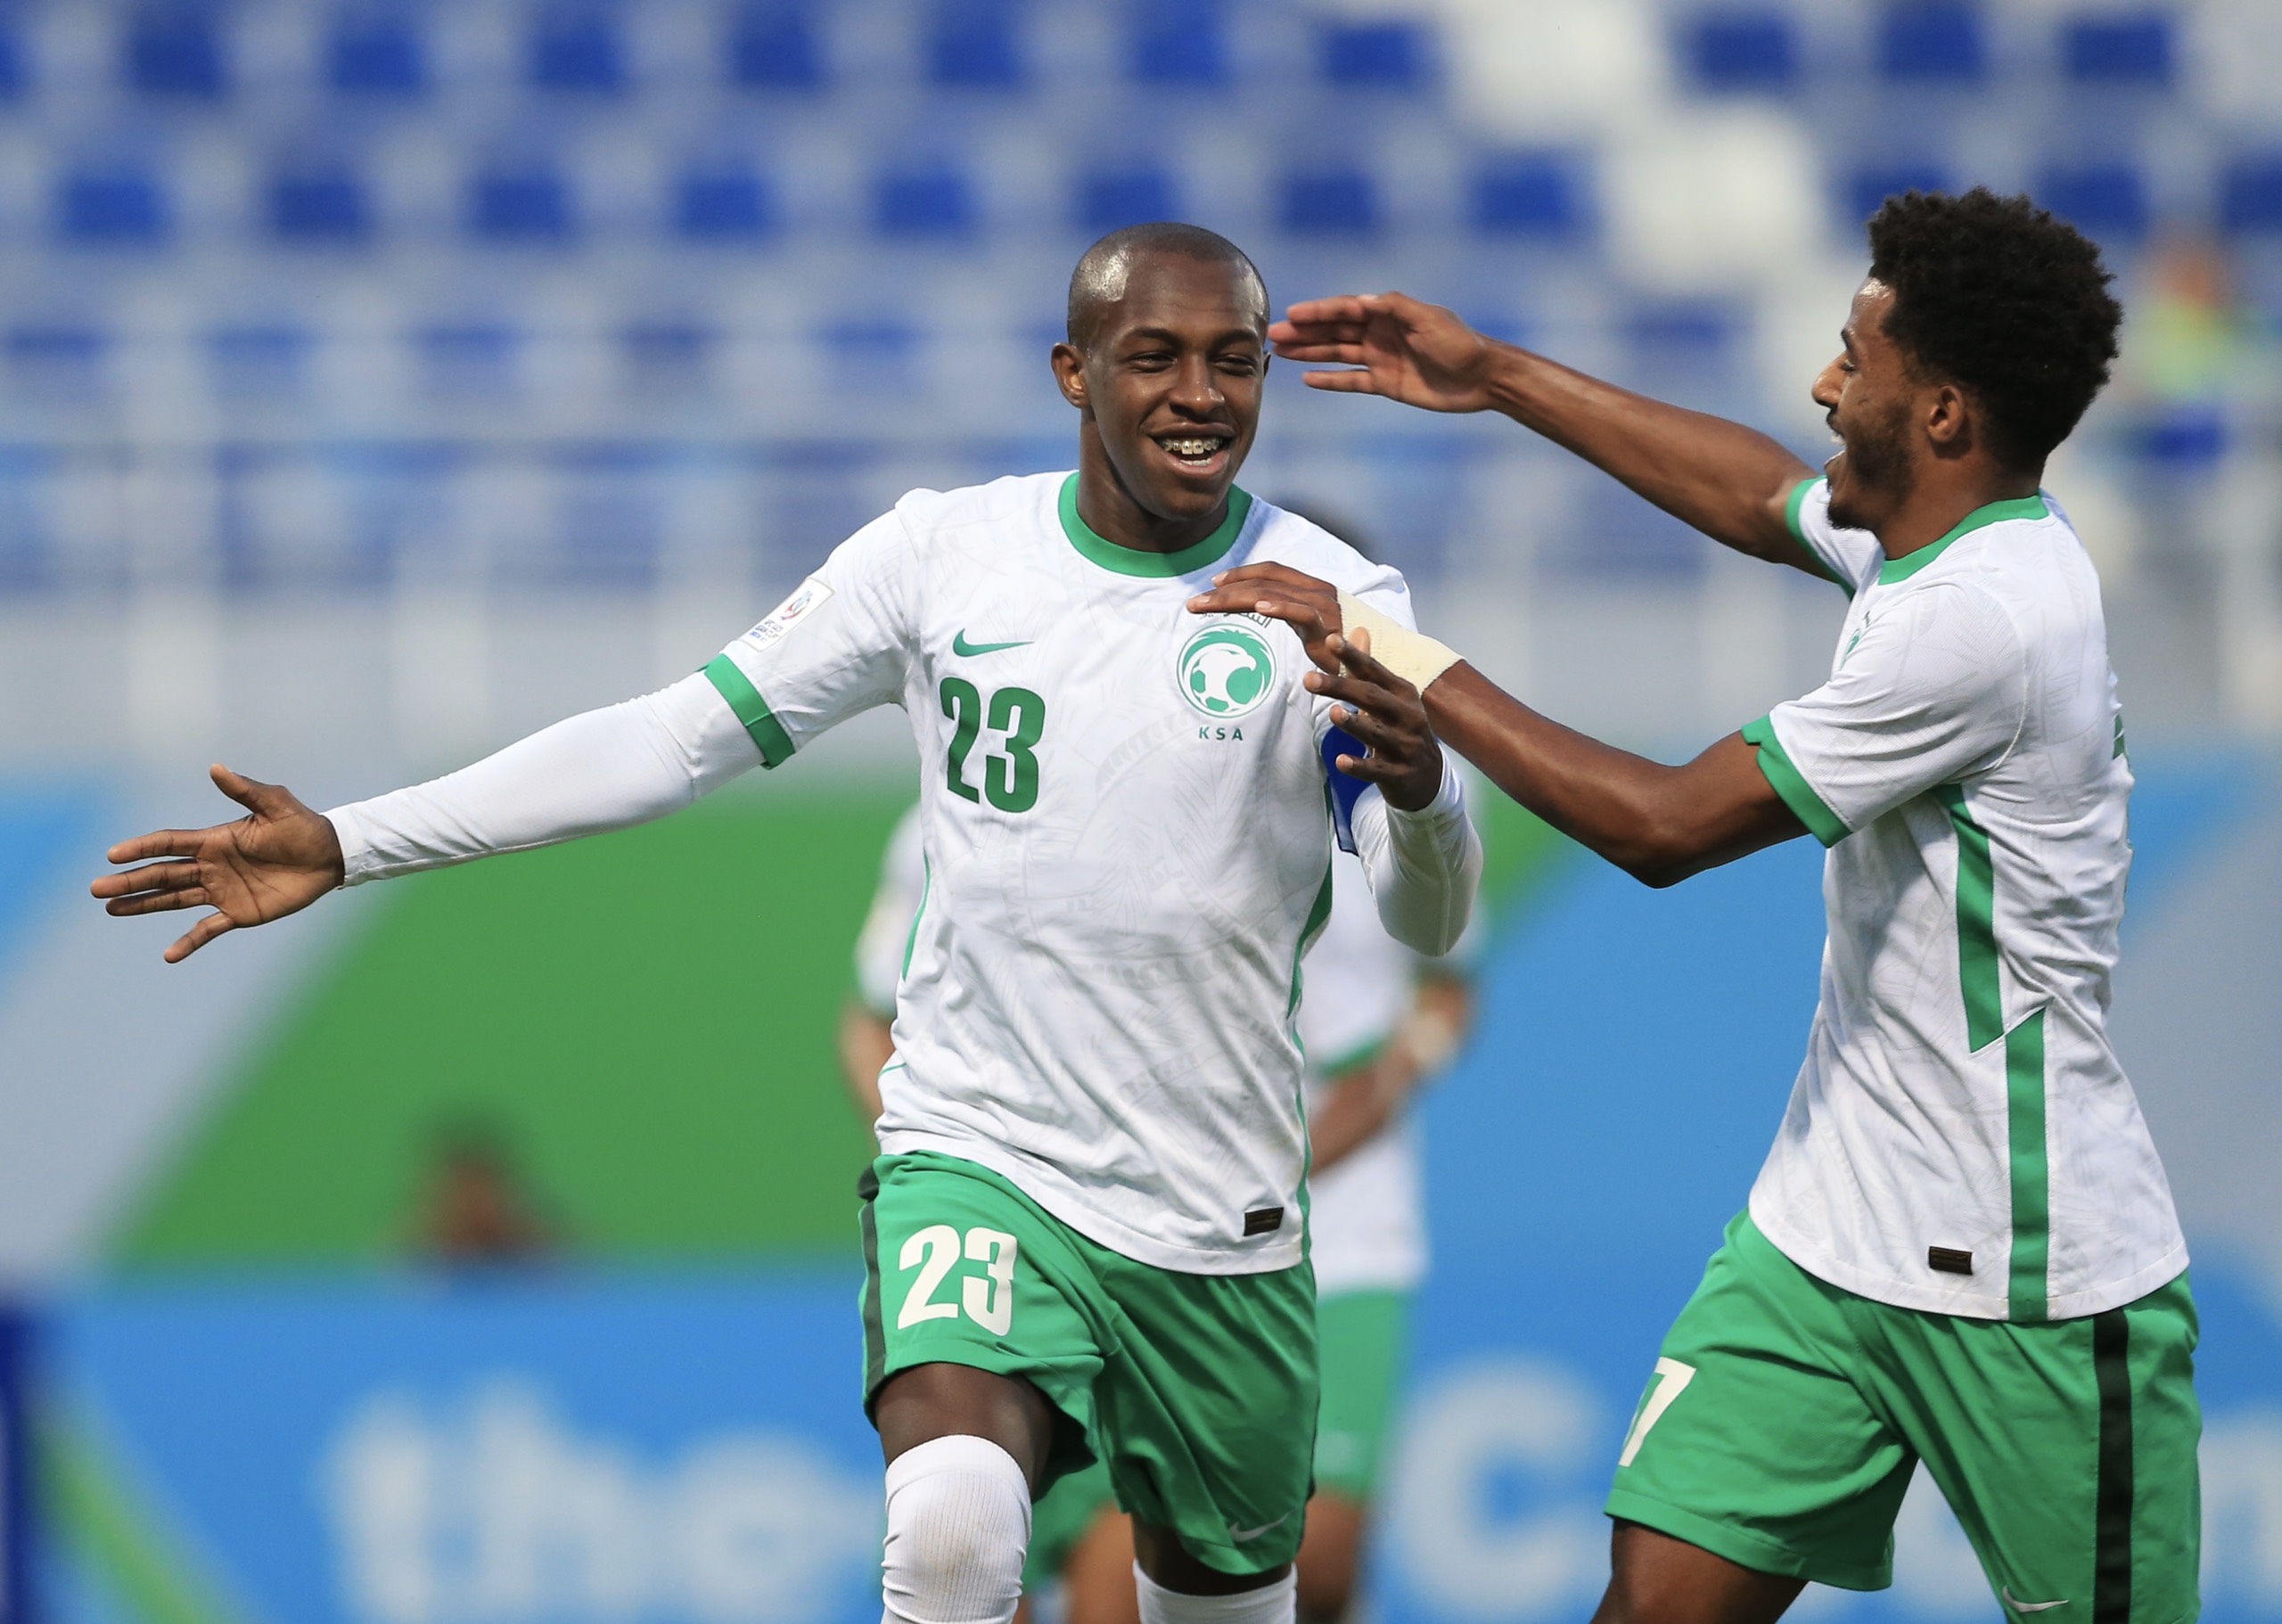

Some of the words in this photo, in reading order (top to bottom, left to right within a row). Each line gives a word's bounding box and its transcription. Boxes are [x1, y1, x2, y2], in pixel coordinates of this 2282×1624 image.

[940, 677, 1047, 814] 23
[1199, 727, 1244, 742] KSA
[898, 1224, 1018, 1336] 23
[1618, 1356, 1697, 1468] 7
